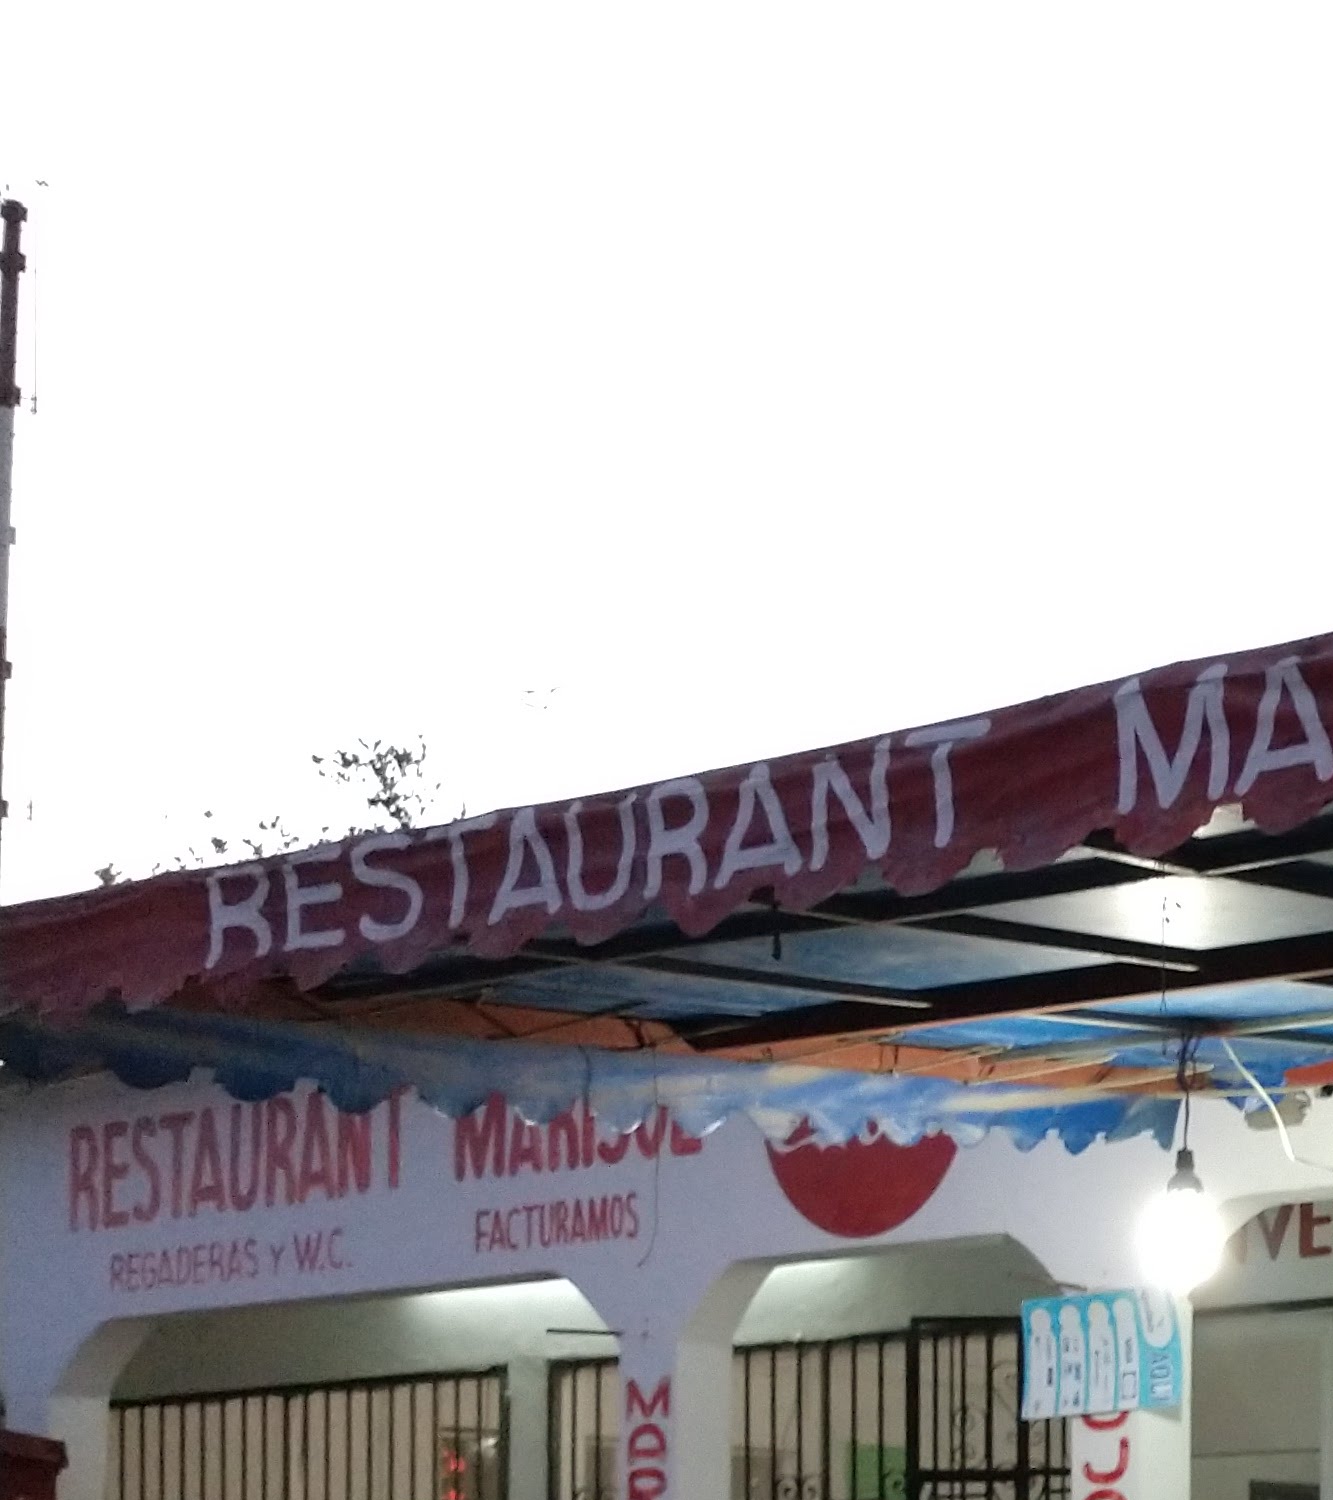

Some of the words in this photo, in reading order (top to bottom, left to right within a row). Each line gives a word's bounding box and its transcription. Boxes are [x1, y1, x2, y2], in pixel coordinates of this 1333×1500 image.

[206, 719, 990, 970] RESTAURANT
[66, 1087, 406, 1232] RESTAURANT
[108, 1240, 259, 1294] REGADERAS
[294, 1230, 354, 1273] W.C.
[475, 1192, 639, 1253] FACTURAMOS
